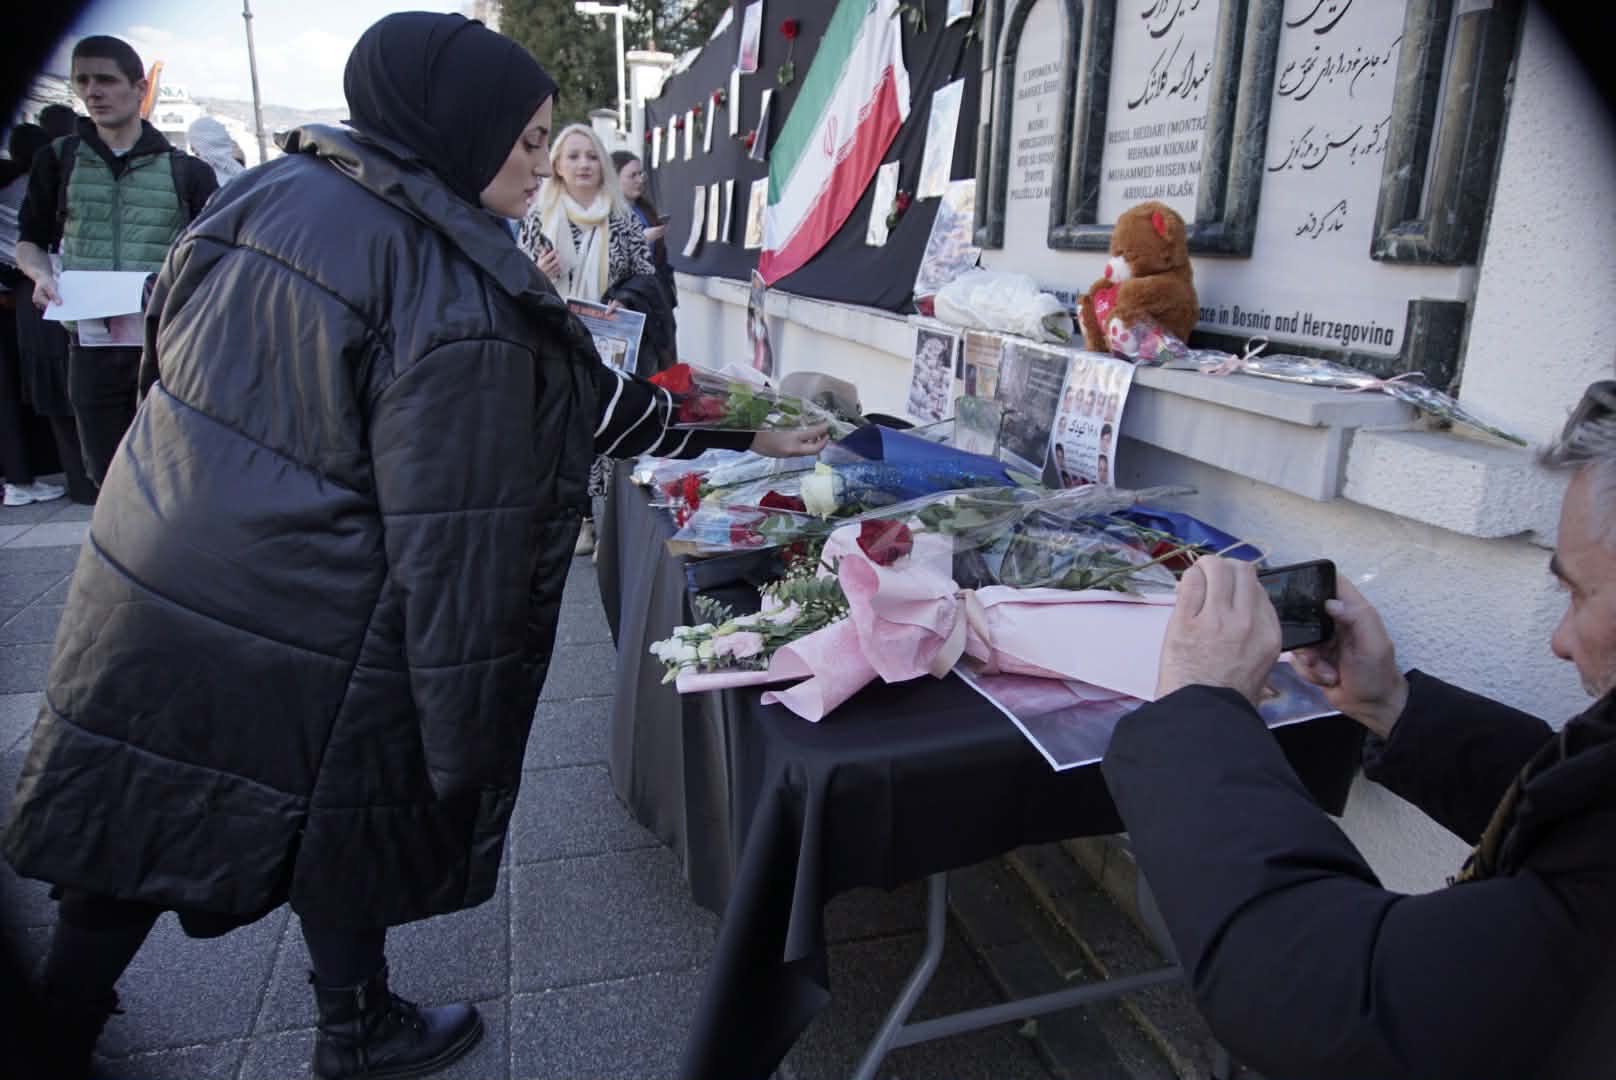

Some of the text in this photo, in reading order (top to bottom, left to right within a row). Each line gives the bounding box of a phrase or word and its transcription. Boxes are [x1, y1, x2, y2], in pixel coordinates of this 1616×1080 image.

[1199, 303, 1395, 347] ace in Bosnia and Herzegovina
